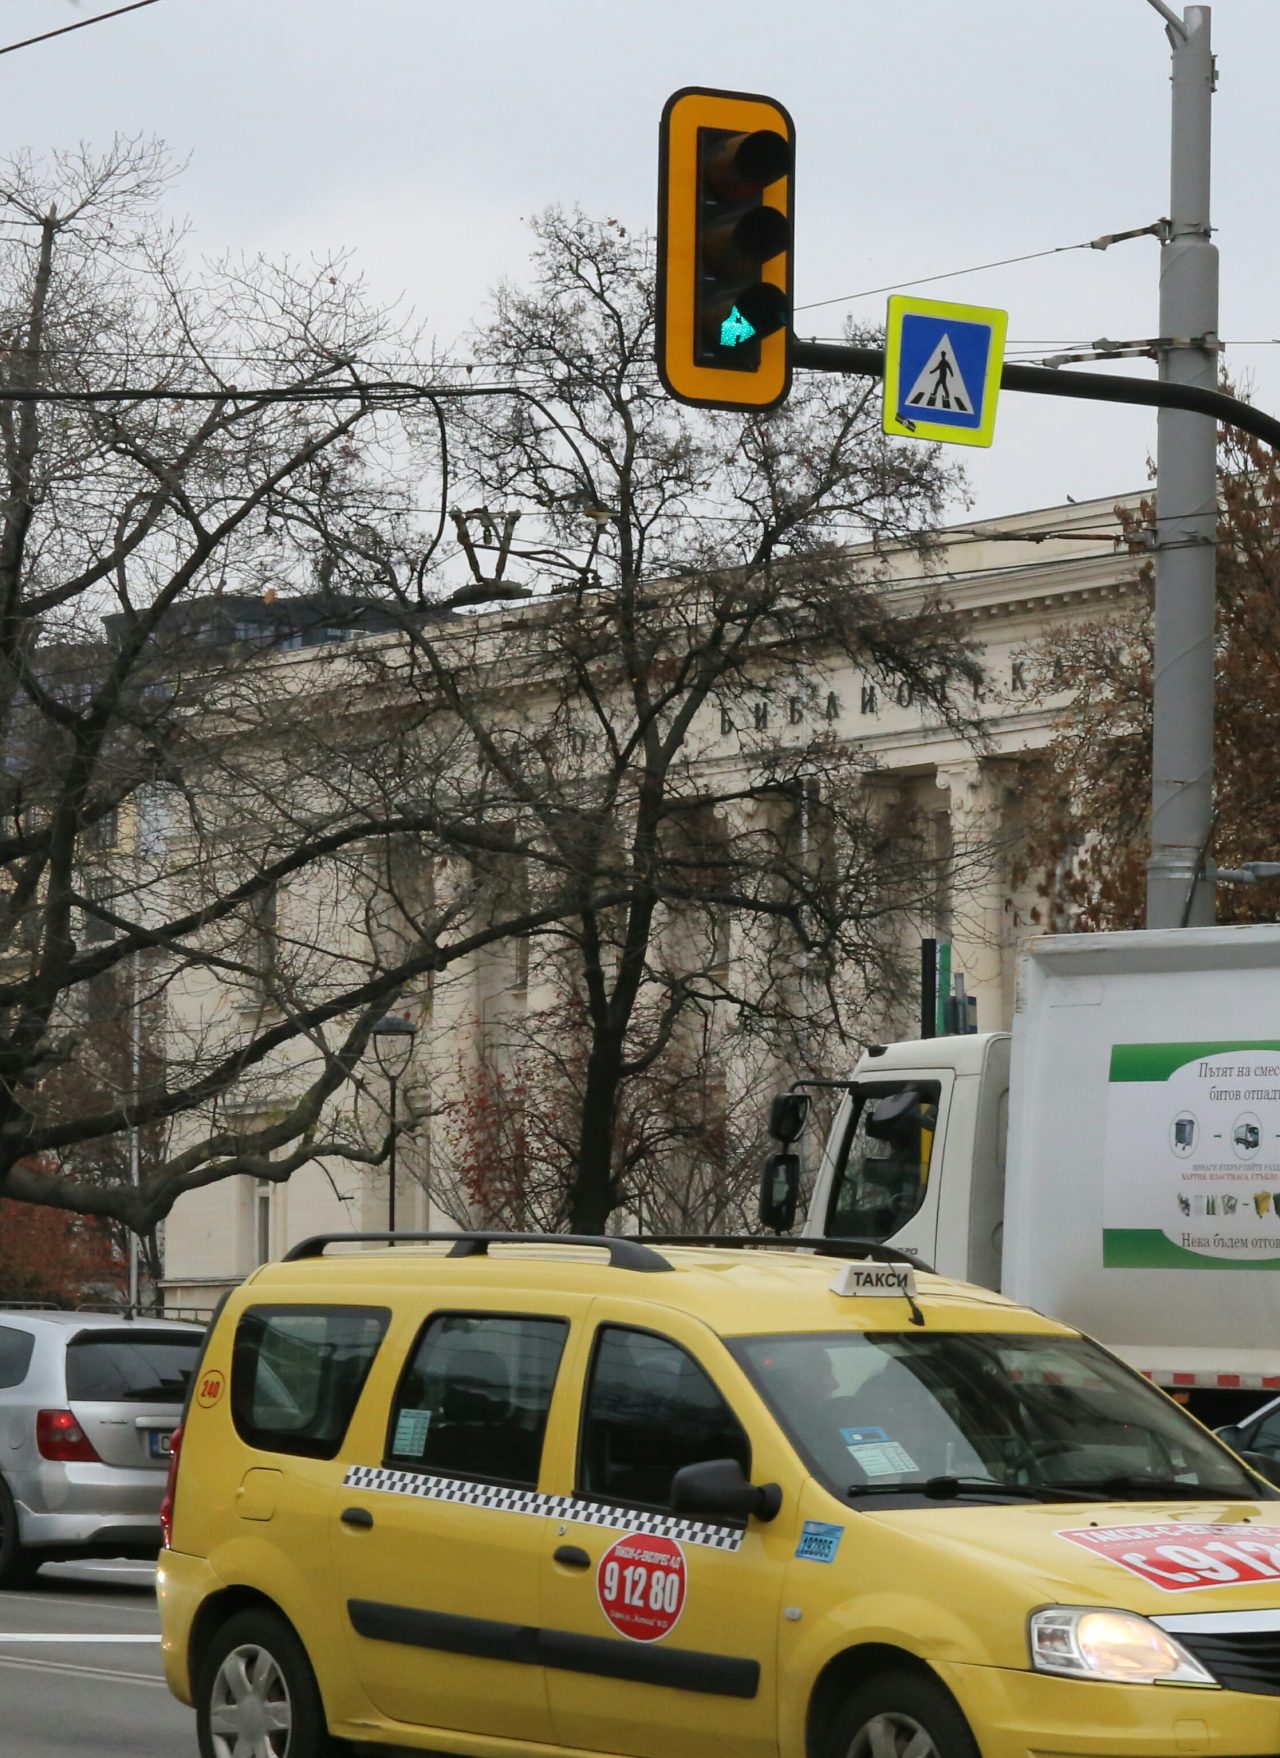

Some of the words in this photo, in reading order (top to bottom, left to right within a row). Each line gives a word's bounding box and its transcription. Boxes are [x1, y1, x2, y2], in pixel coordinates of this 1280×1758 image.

[1199, 1062, 1234, 1078] Пътят
[1237, 1066, 1250, 1077] на
[1209, 1085, 1241, 1101] битов
[1181, 1232, 1210, 1248] Нека
[1213, 1233, 1248, 1249] бъдем
[854, 1272, 908, 1288] ТАКСИ
[201, 1379, 220, 1398] 240
[603, 1561, 619, 1602] 9
[623, 1565, 647, 1607] 12
[649, 1570, 680, 1614] 80
